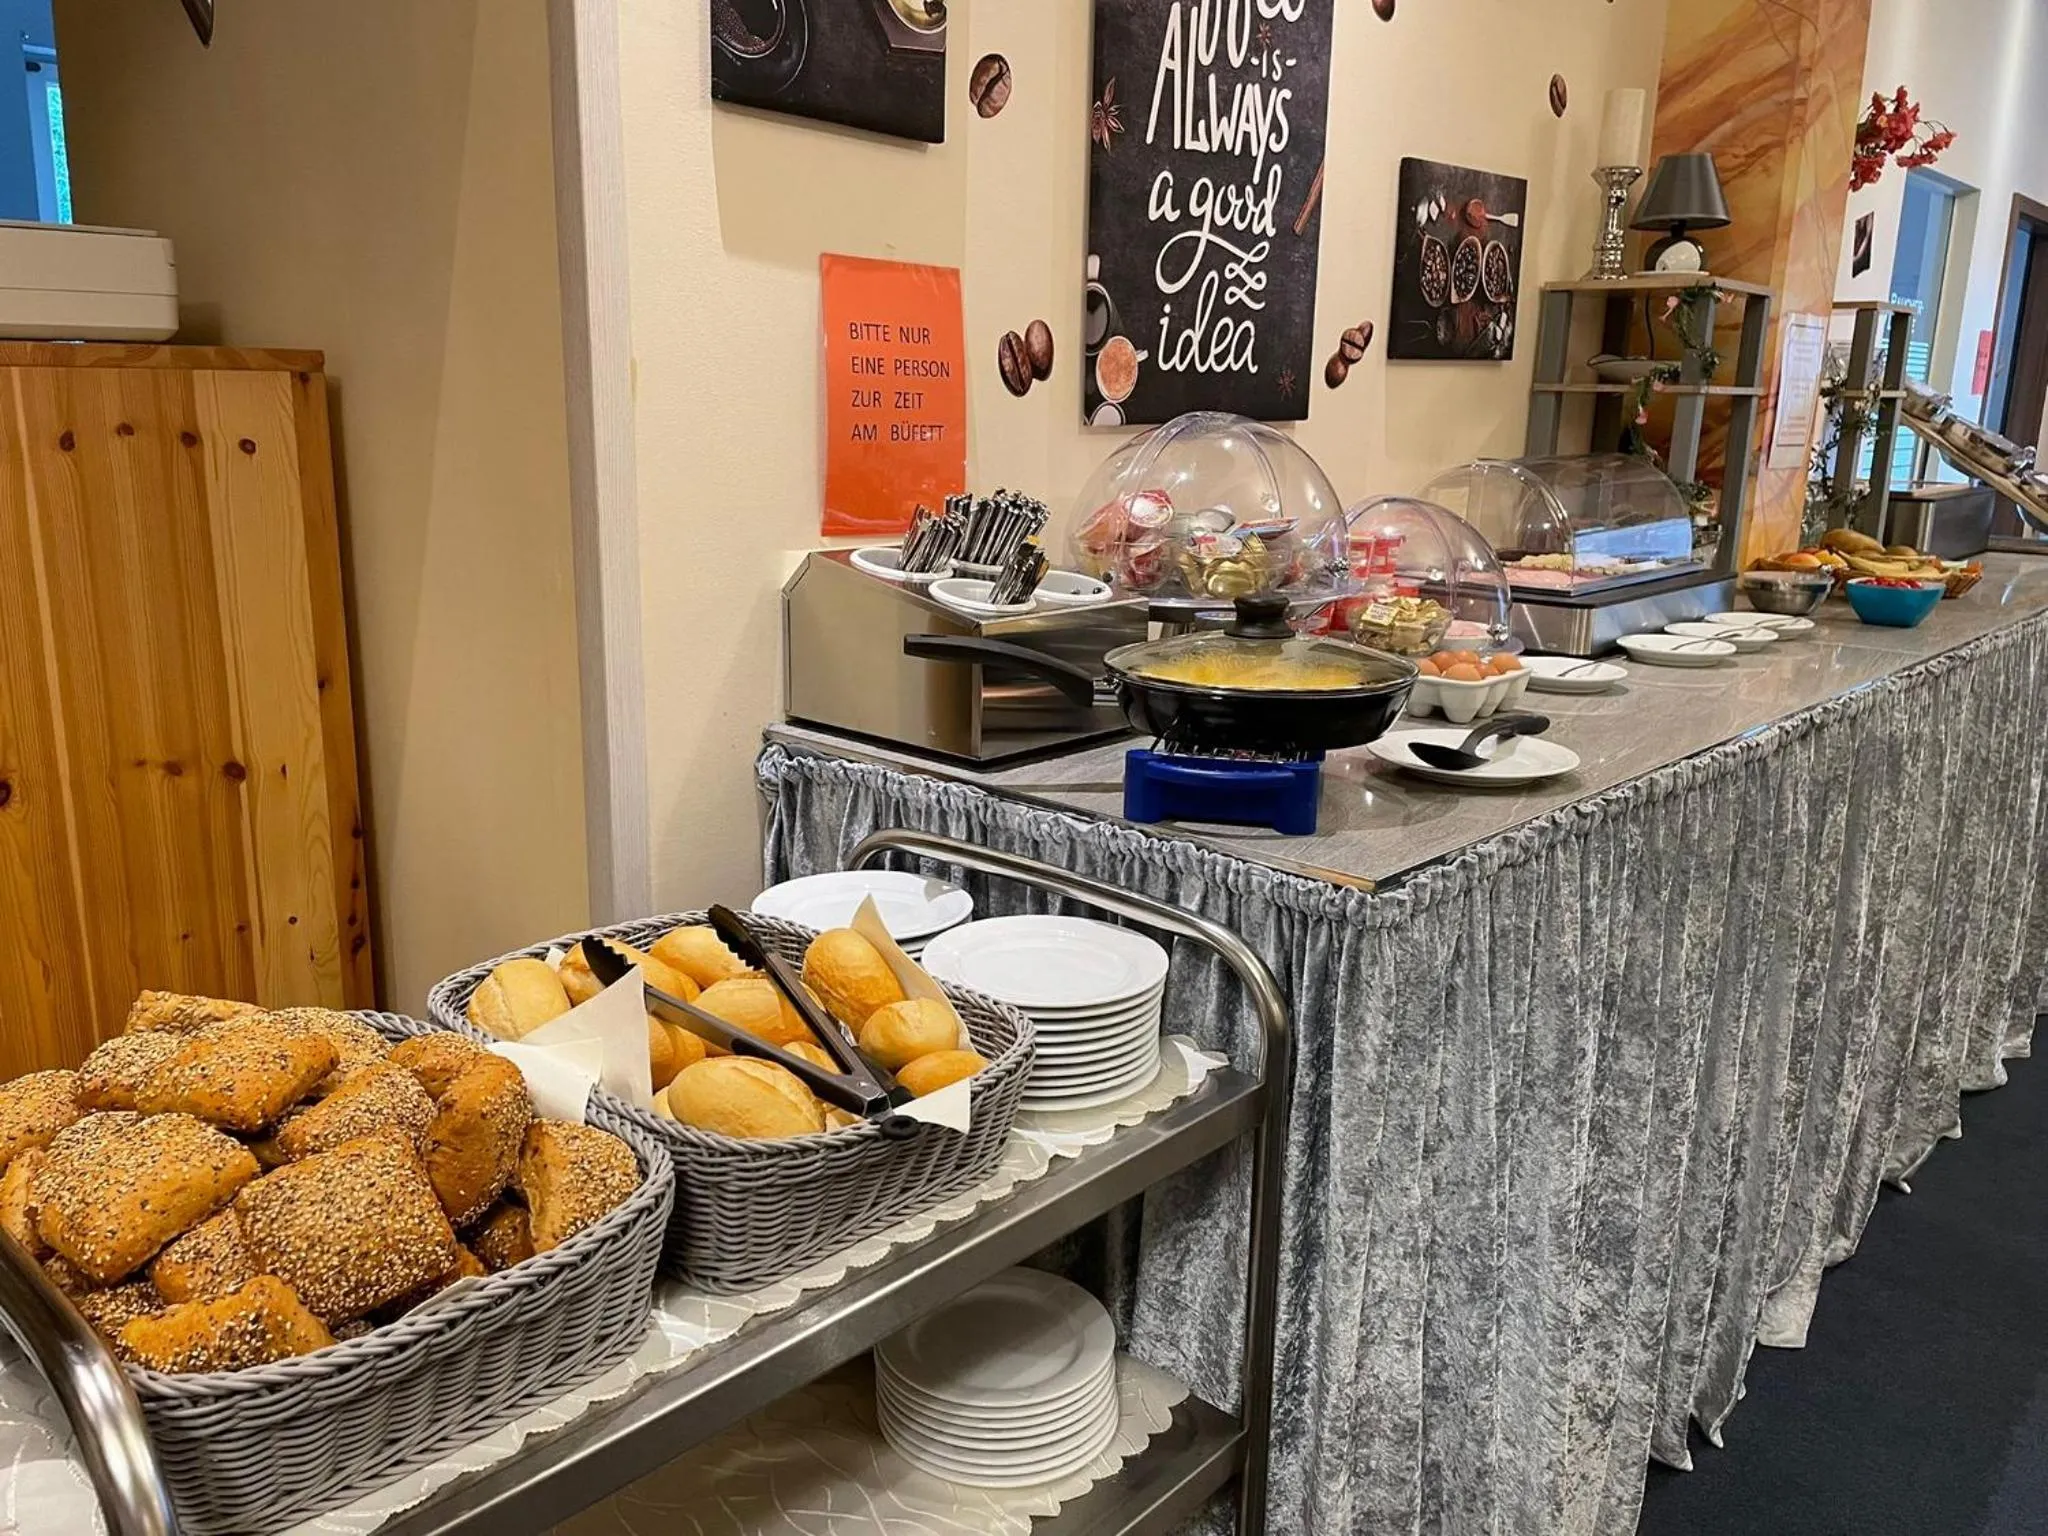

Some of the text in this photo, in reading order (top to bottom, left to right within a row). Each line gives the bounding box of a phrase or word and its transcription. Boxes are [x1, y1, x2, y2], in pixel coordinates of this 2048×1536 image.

[1146, 2, 1292, 184] ALWAYS
[1149, 164, 1282, 296] a good
[849, 322, 931, 345] BITTE NUR
[1158, 271, 1258, 374] idea
[851, 356, 950, 378] EINE PERSON
[851, 390, 924, 409] ZUR ZEIT
[851, 420, 945, 442] AM BÜFETT
